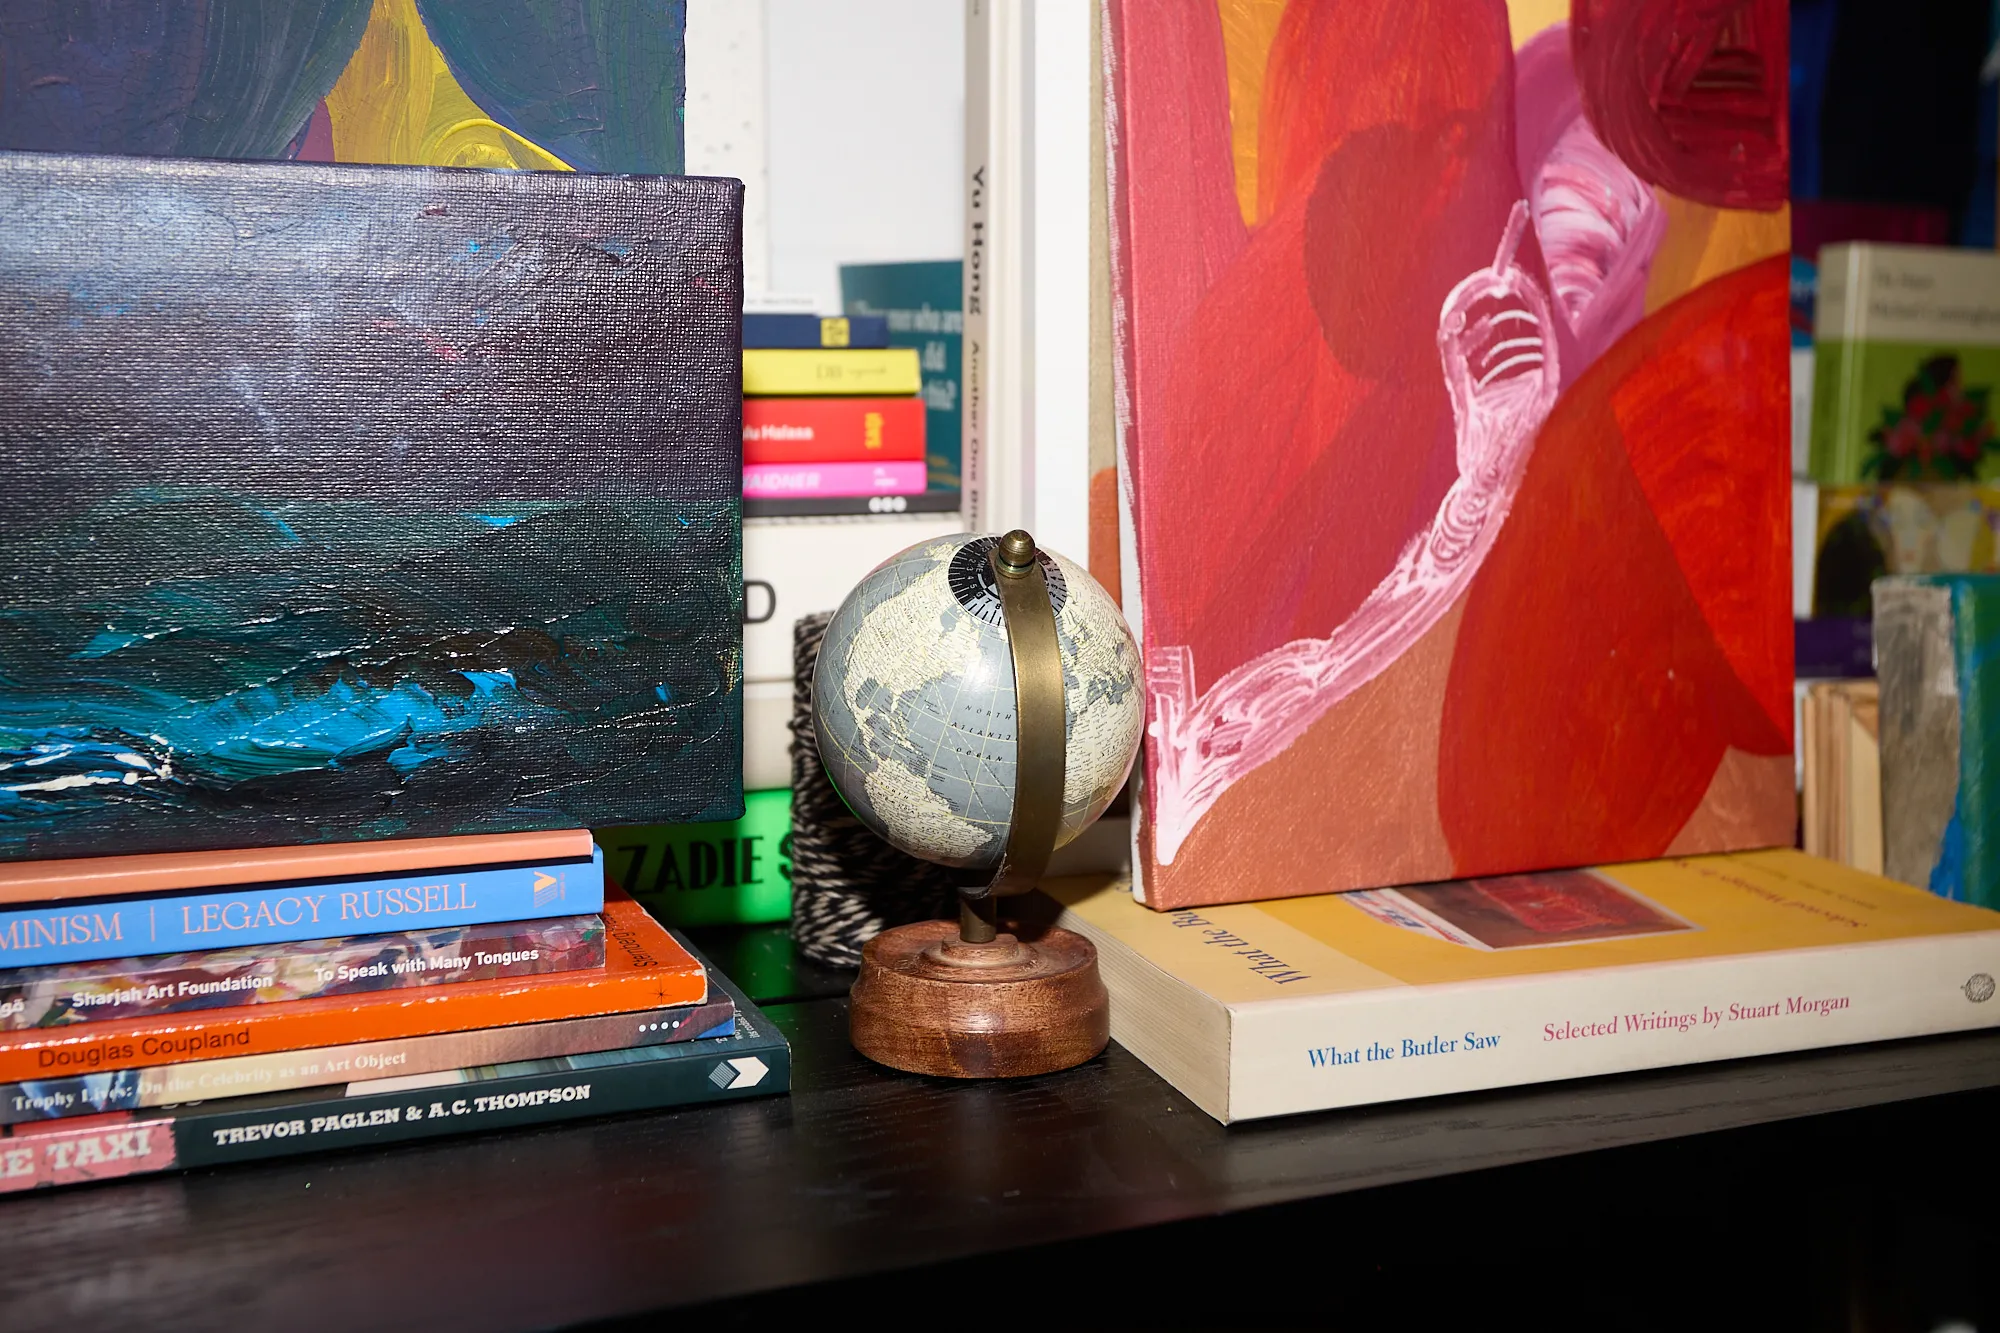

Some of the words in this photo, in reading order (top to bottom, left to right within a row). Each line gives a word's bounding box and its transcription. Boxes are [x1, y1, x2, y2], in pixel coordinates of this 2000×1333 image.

[971, 165, 985, 209] Yu
[969, 222, 984, 315] Hong
[951, 722, 1017, 741] ATLANTI
[965, 705, 1012, 720] NORTH
[618, 836, 764, 896] ZADIE
[778, 831, 793, 882] S
[183, 895, 331, 934] LEGACY
[340, 883, 477, 920] RUSSELL
[1171, 911, 1215, 928] Bu
[1203, 928, 1249, 948] the
[72, 986, 143, 1007] Sharjah
[146, 984, 175, 1000] Art
[178, 974, 273, 997] Foundation
[314, 967, 335, 982] To
[338, 963, 388, 981] Speak
[392, 957, 427, 974] with
[429, 954, 472, 973] Many
[474, 948, 539, 968] Tongues
[1233, 949, 1312, 985] What
[38, 1043, 134, 1068] Douglas
[141, 1028, 250, 1057] Coupland
[1308, 1047, 1361, 1069] What
[1366, 1041, 1395, 1062] the
[1400, 1035, 1458, 1059] Butler
[1463, 1031, 1502, 1052] Saw
[1543, 1015, 1618, 1043] Selected
[1624, 1010, 1698, 1036] Writings
[1702, 1006, 1724, 1029] by
[1728, 1000, 1781, 1022] Stuart
[1785, 995, 1851, 1020] Morgan
[12, 1092, 76, 1111] Trophy
[81, 1084, 133, 1103] Lives:
[138, 1081, 163, 1095] On
[167, 1076, 195, 1092] the
[199, 1067, 274, 1089] Celebrity
[279, 1066, 296, 1078] as
[300, 1063, 319, 1076] an
[324, 1059, 352, 1072] Art
[355, 1050, 407, 1070] Object
[0, 1148, 35, 1179] E
[47, 1129, 152, 1171] TAXI
[213, 1120, 305, 1146] TREVOR
[310, 1107, 400, 1134] PAGLEN
[405, 1106, 422, 1122] &
[428, 1099, 472, 1120] A.C.
[474, 1084, 592, 1113] THOMPSON
